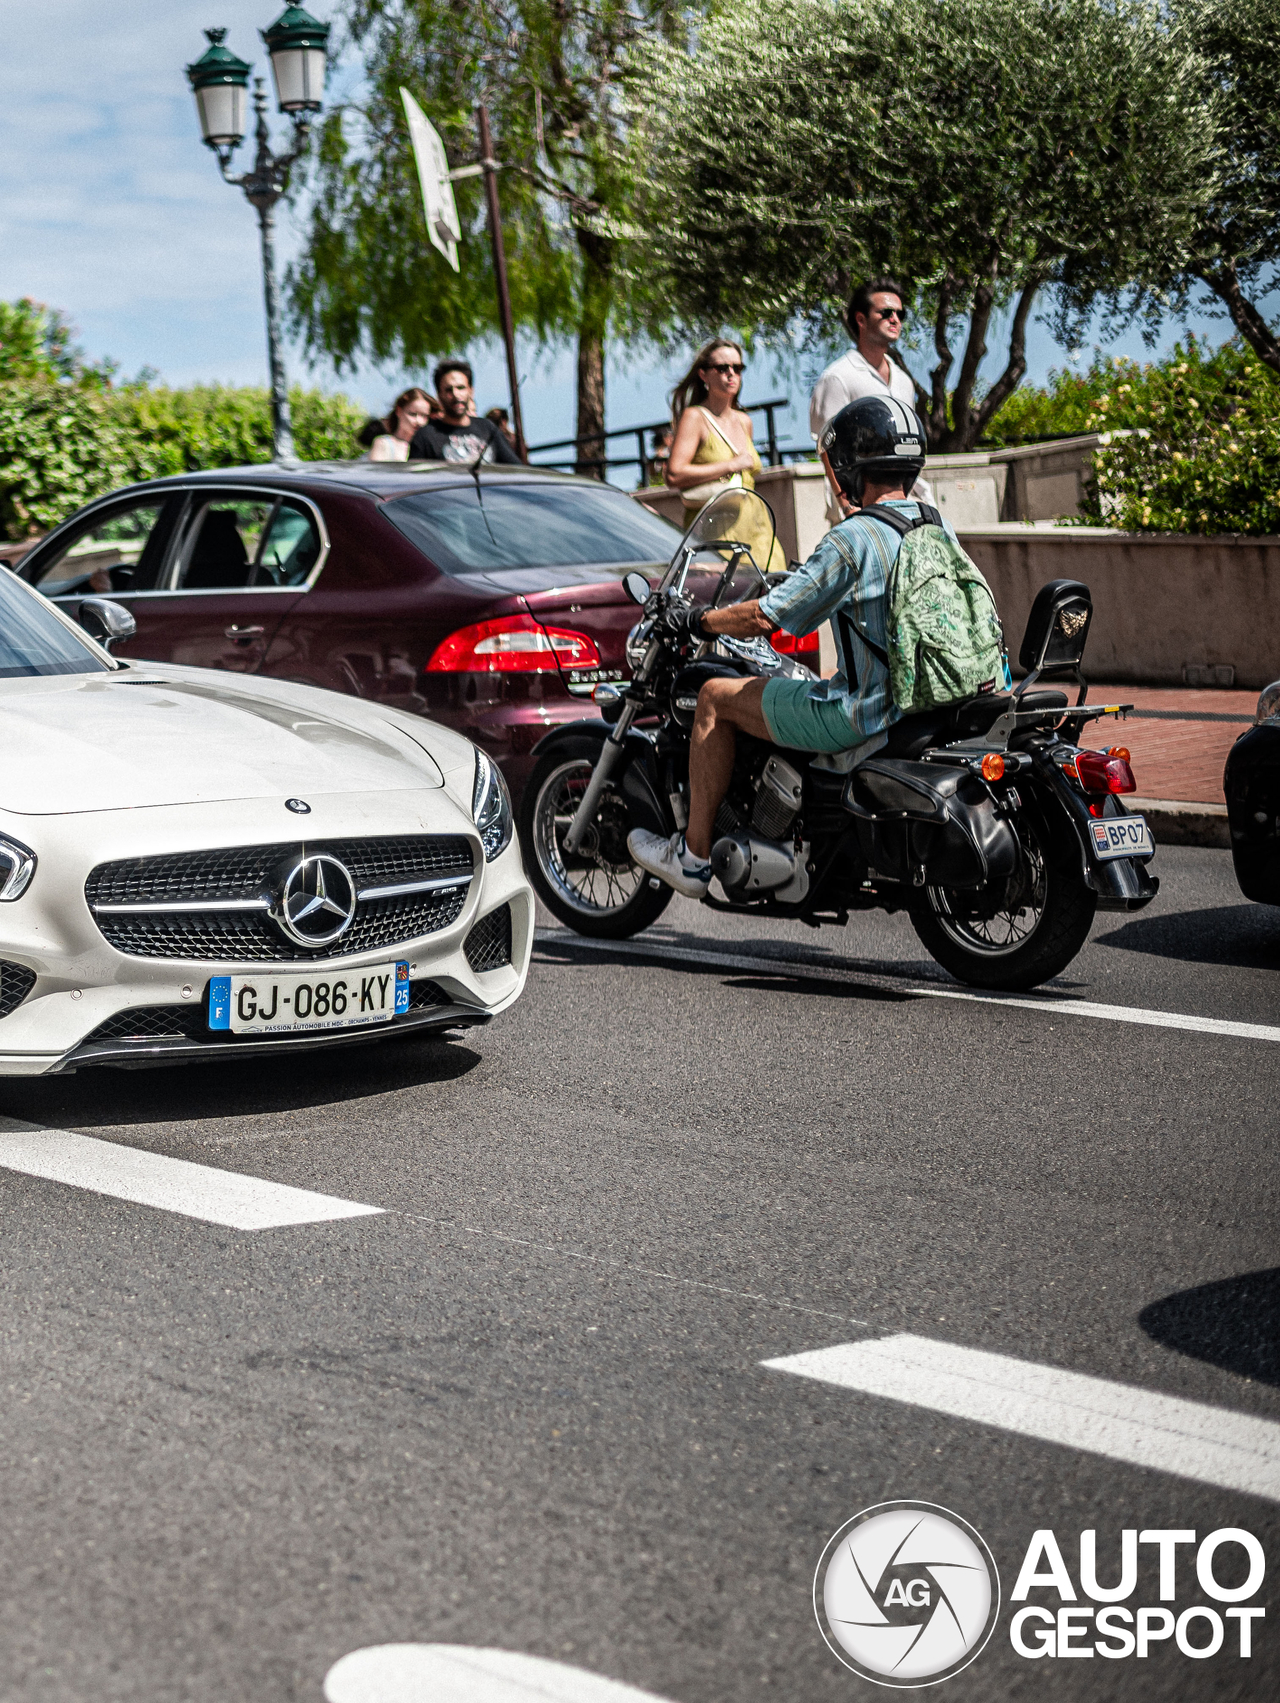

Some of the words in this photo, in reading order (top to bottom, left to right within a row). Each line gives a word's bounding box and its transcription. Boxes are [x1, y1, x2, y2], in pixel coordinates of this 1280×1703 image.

[1107, 824, 1144, 846] BP07
[237, 974, 390, 1021] GJ-086-KY
[396, 989, 408, 1006] 25
[215, 1007, 223, 1018] F
[292, 1022, 330, 1030] AUTOMOBILE
